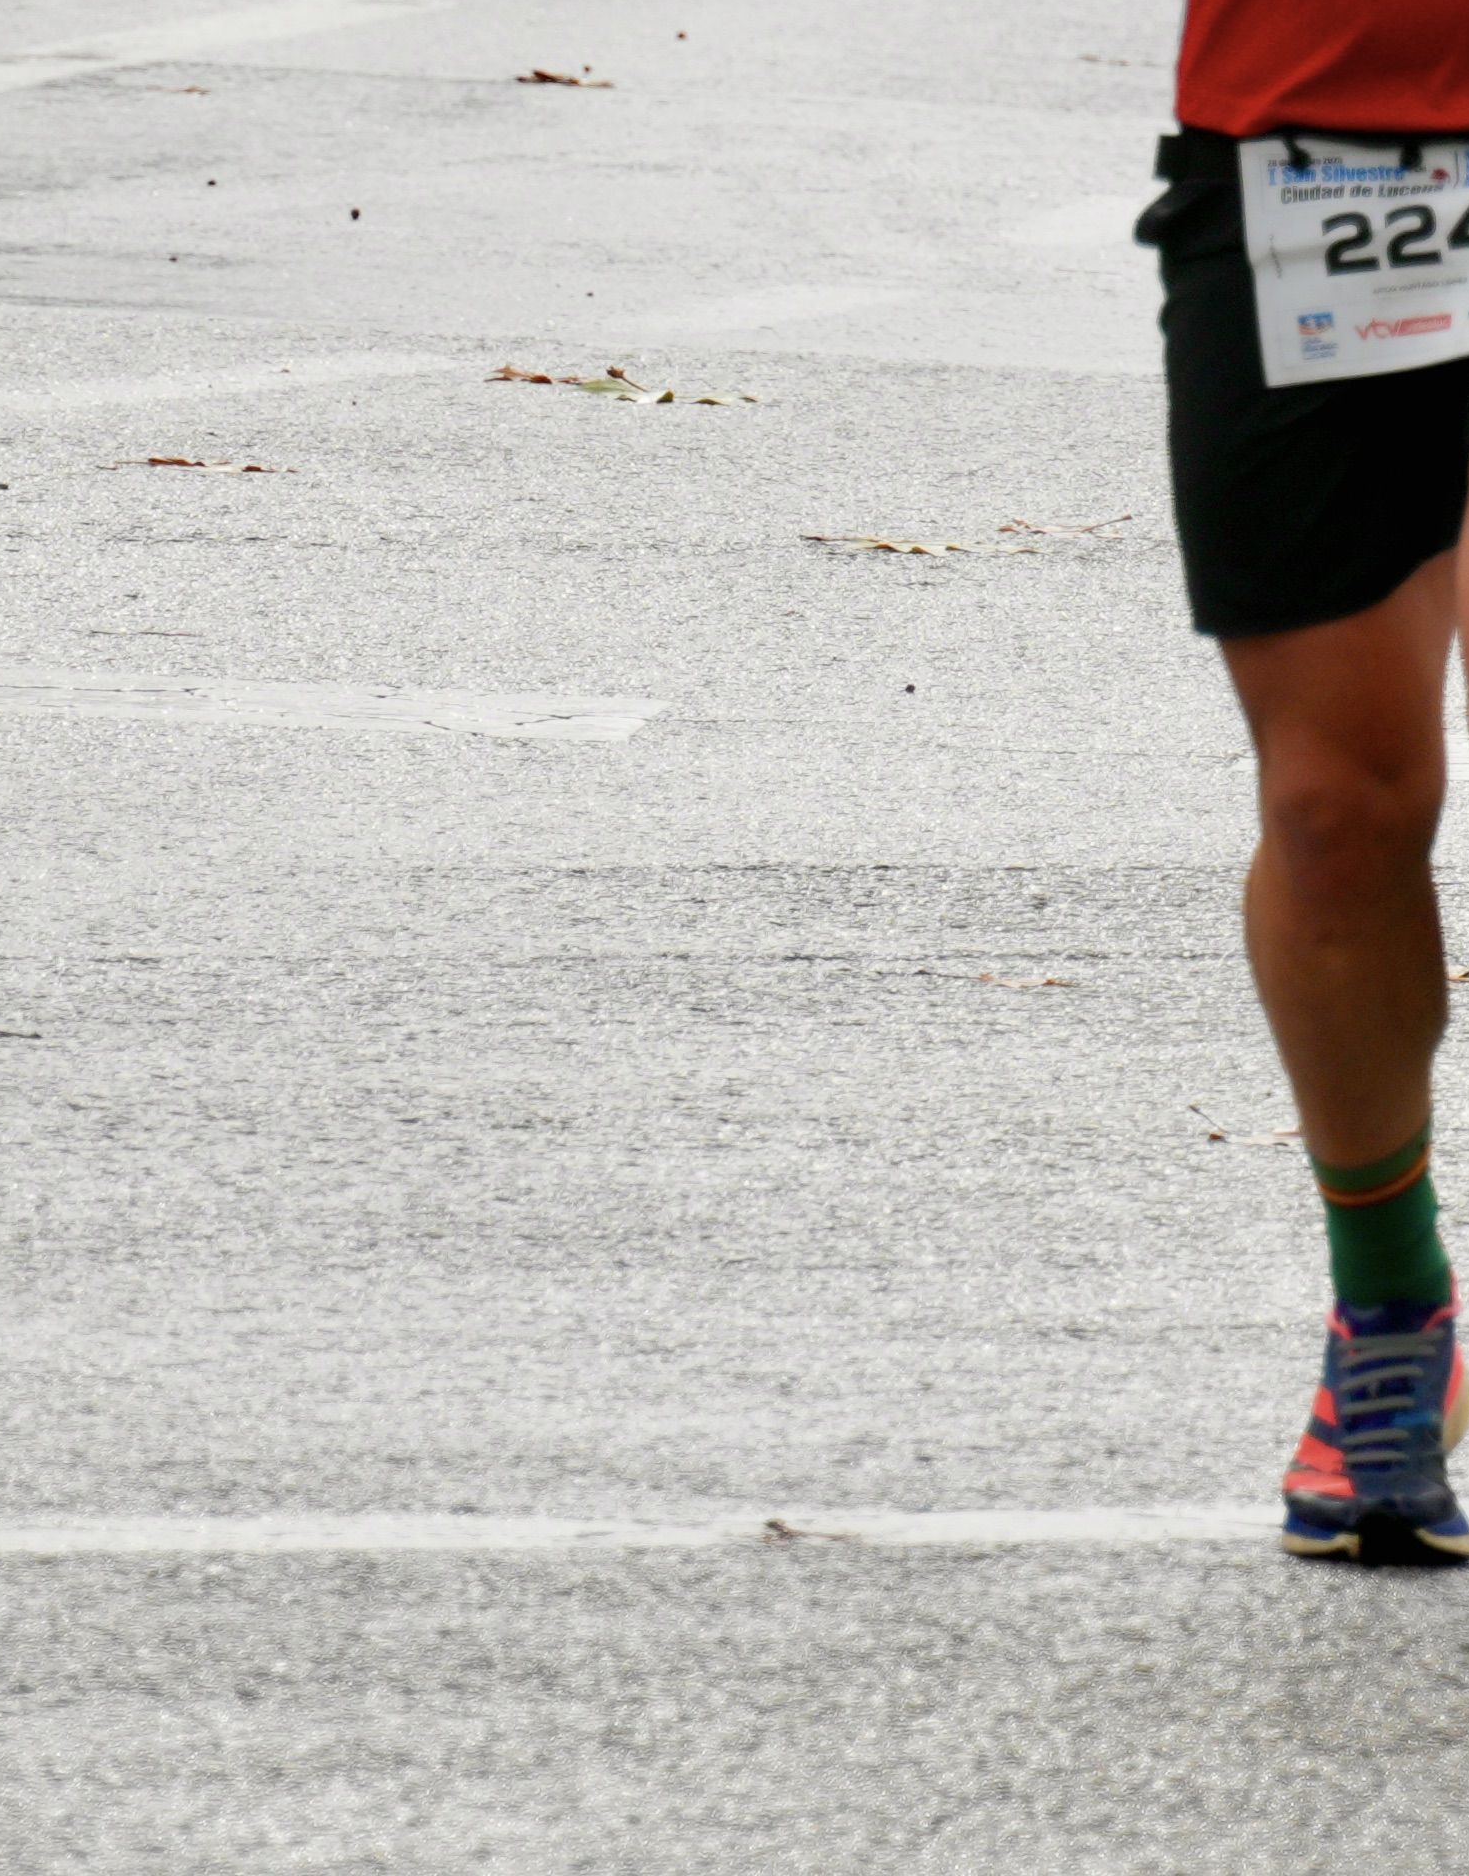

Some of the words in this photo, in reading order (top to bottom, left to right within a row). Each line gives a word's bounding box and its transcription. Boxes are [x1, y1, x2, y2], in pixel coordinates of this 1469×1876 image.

[1320, 164, 1407, 184] Silvestre
[1280, 184, 1345, 206] Ciudad
[1349, 183, 1374, 199] de
